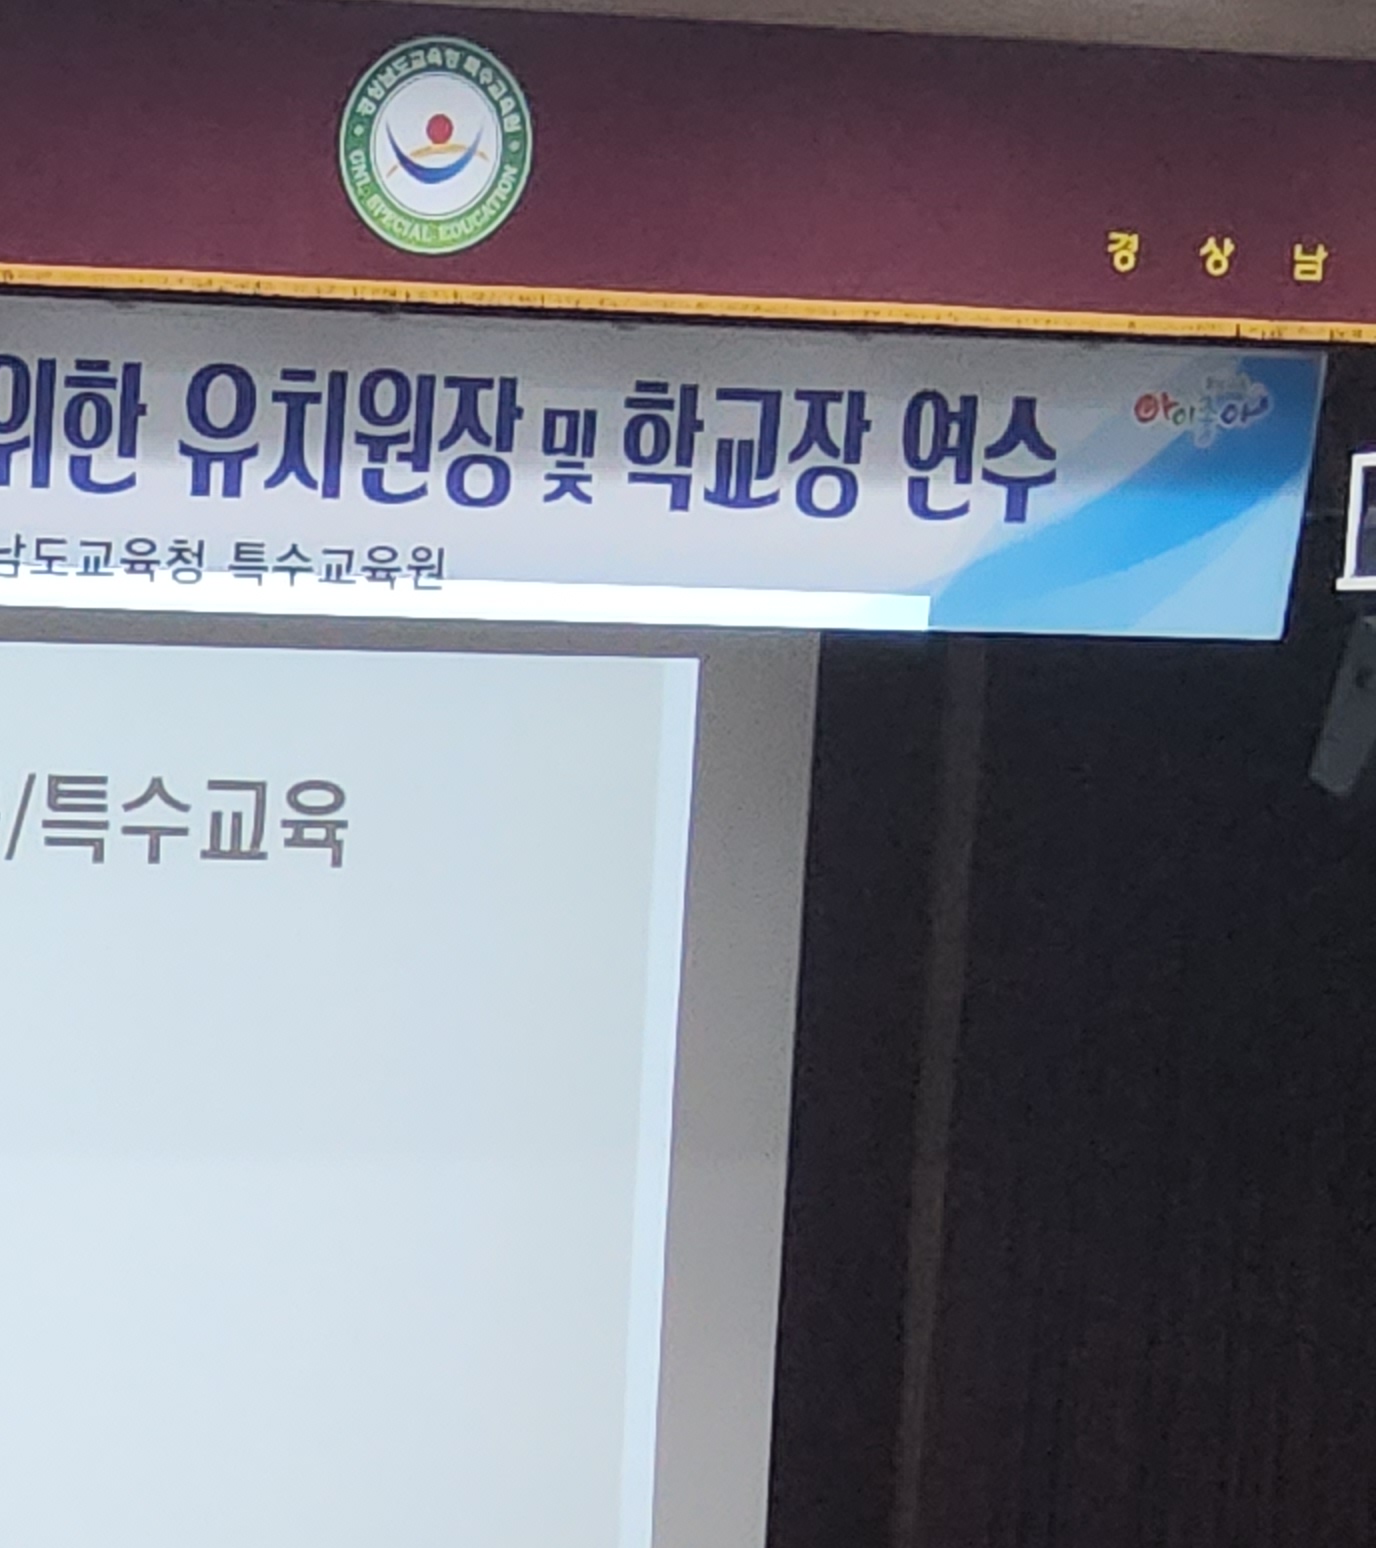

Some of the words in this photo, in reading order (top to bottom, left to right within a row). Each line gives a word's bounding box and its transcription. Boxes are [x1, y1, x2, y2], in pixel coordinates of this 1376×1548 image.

[178, 362, 524, 508] 유치원장
[541, 407, 599, 505] 및
[622, 379, 873, 520] 학교장
[901, 390, 1058, 524] 연수
[227, 540, 446, 592] 특수교육원
